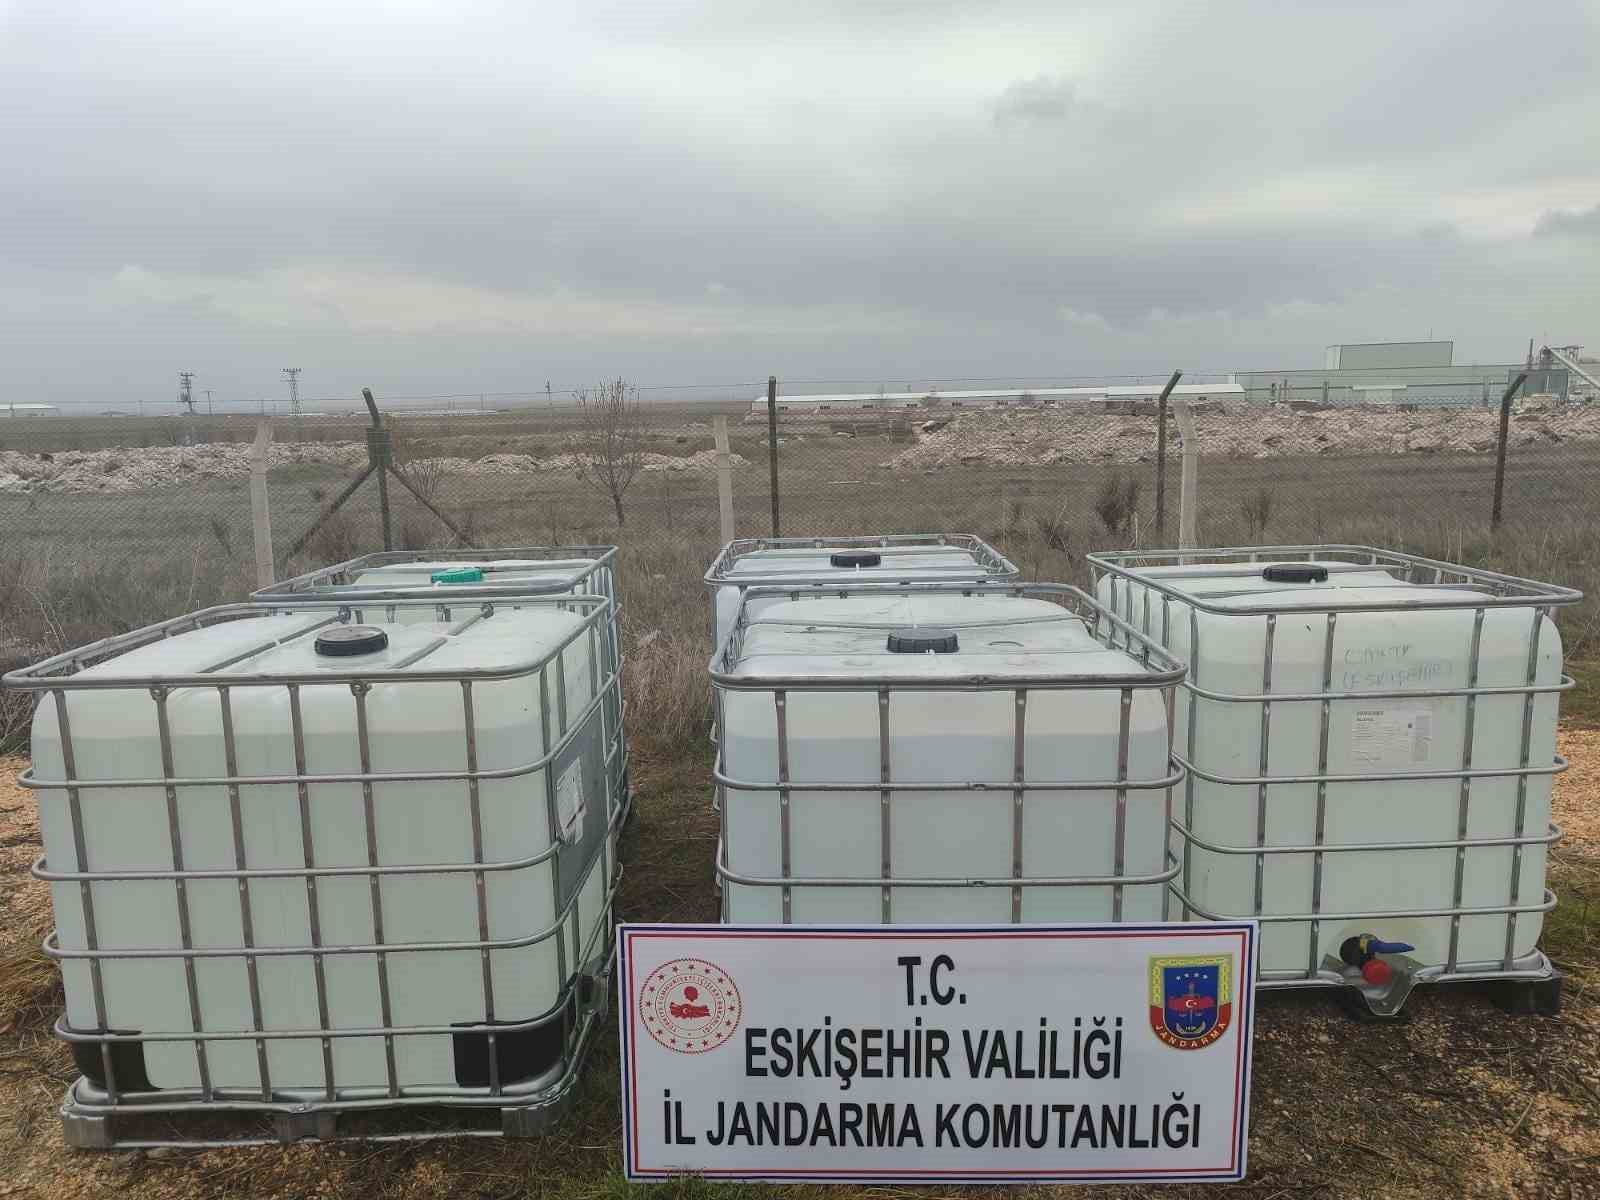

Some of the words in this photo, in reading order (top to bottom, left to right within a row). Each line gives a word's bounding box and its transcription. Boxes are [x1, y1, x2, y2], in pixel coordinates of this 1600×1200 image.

[897, 954, 967, 1006] T.C.
[745, 1016, 951, 1091] ESKİŞEHİR
[962, 1016, 1122, 1080] VALİLİĞİ
[1155, 1022, 1226, 1048] JANDARMA
[663, 1088, 696, 1146] İL
[706, 1101, 925, 1148] JANDARMA
[935, 1091, 1201, 1149] KOMUTANLIĞI
